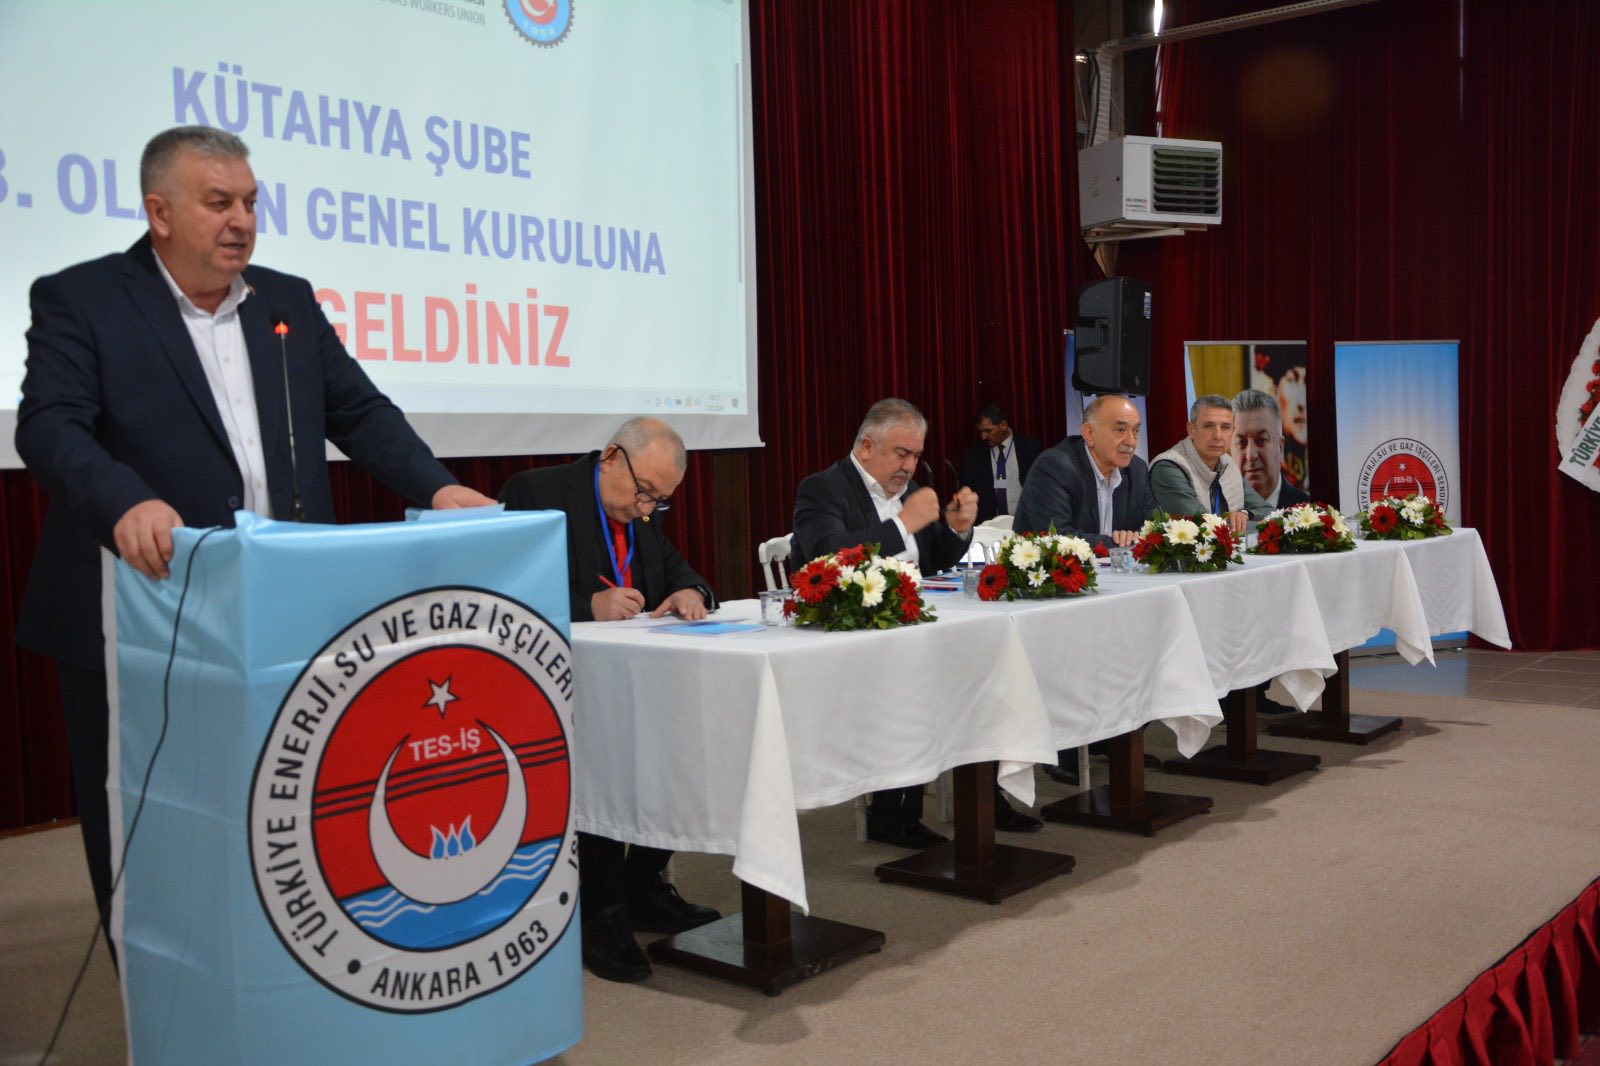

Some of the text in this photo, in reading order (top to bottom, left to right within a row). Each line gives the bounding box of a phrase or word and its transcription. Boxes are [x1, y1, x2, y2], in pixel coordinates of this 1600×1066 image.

[457, 7, 486, 25] UNION
[172, 62, 532, 179] KÜTAHYA ŞUBE
[56, 152, 288, 237] OLN
[306, 187, 450, 253] GENEL
[462, 206, 667, 276] KURULUNA
[314, 282, 571, 368] GELDİNİZ
[1388, 442, 1397, 452] VE
[1400, 442, 1414, 451] GAZ
[266, 816, 339, 957] TÜRKİYE
[382, 610, 417, 644] VE
[429, 602, 480, 630] GAZ
[409, 727, 481, 762] TES-İŞ
[370, 920, 549, 1001] ANKARA 1963
